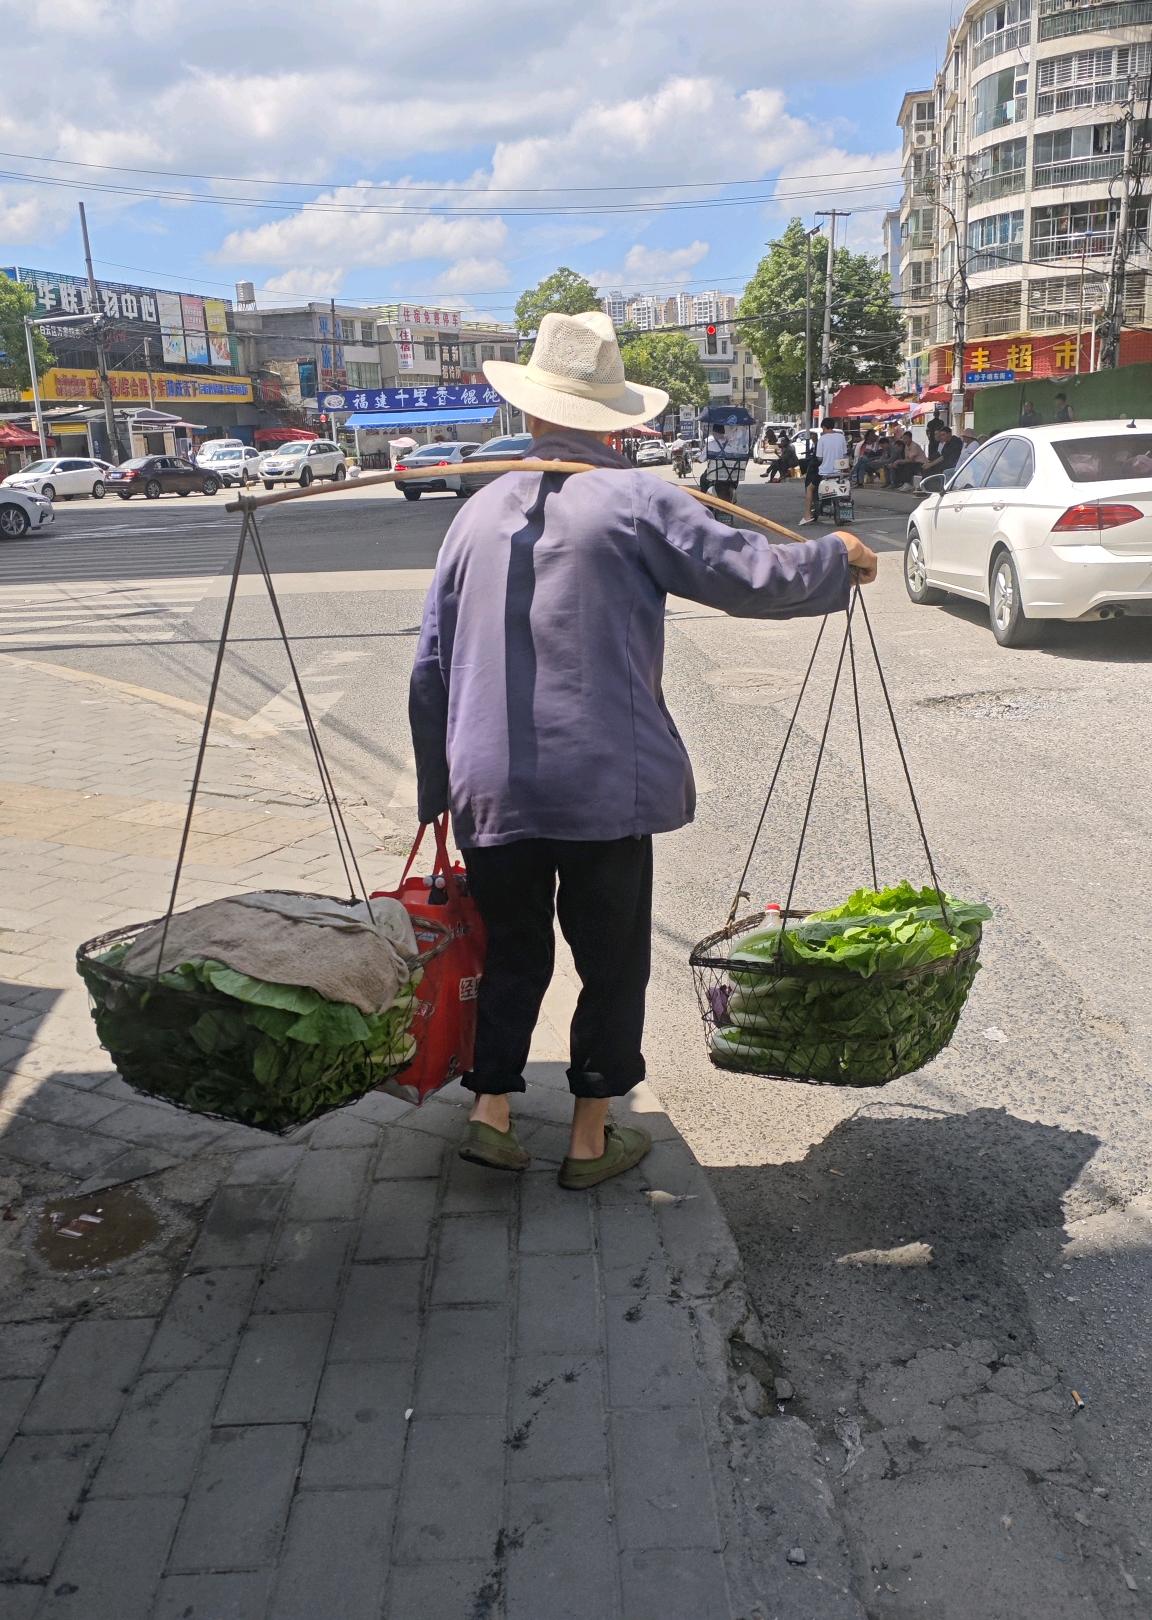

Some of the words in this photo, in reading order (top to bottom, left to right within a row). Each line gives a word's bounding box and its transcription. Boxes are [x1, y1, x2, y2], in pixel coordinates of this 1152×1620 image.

[945, 340, 1078, 375] 丰超市
[352, 386, 501, 409] 福建千里香馄饨
